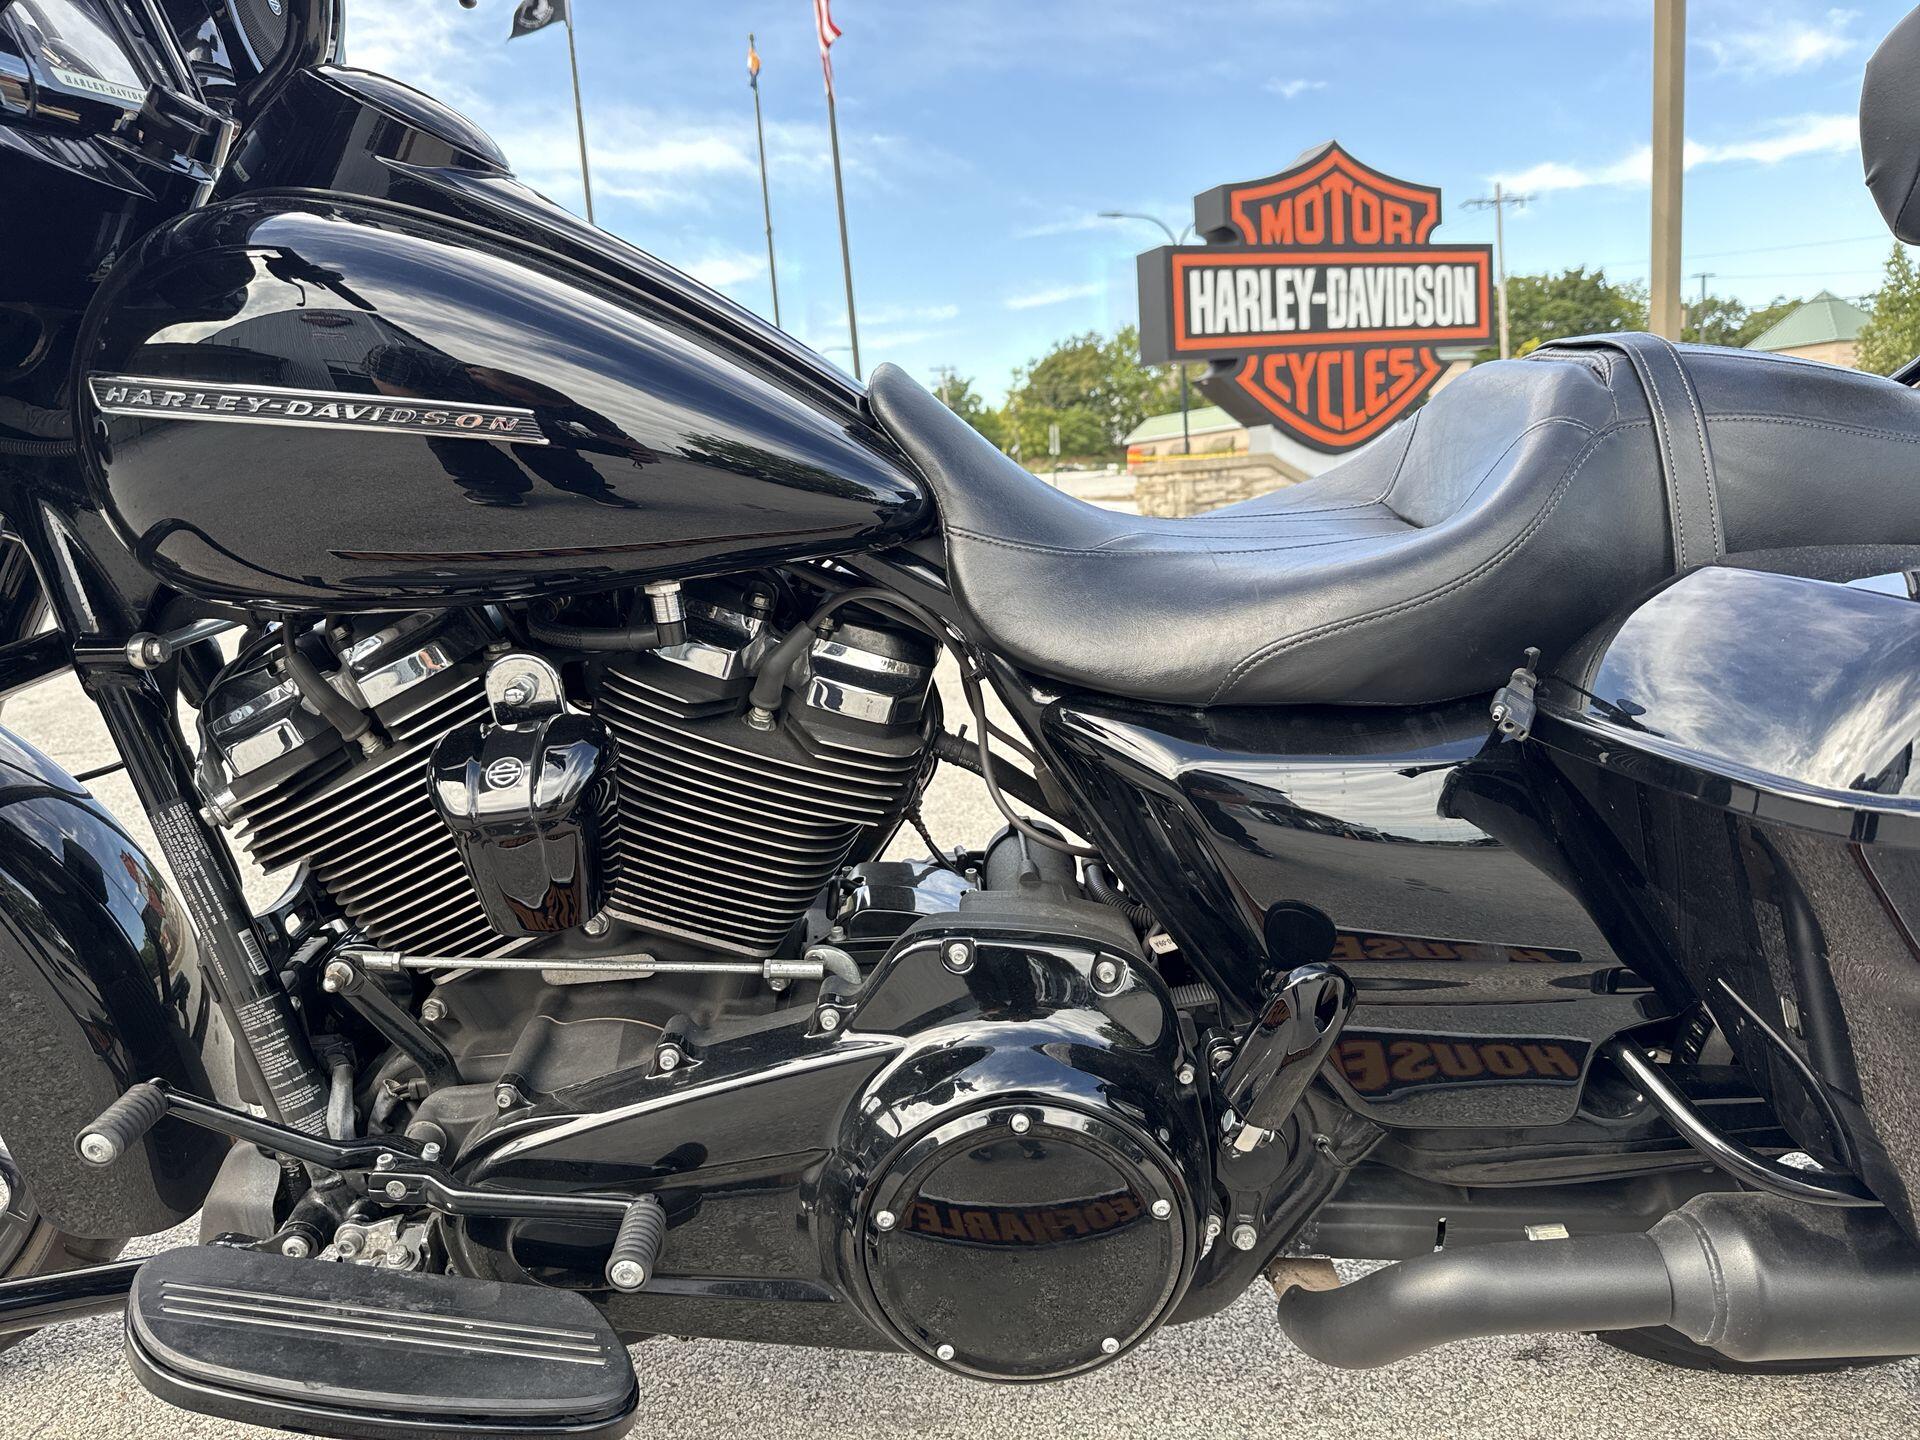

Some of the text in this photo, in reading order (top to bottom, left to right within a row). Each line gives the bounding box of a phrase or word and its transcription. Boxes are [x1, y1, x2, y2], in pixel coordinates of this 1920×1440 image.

[1261, 171, 1413, 245] MOTOR
[1189, 264, 1476, 335] HARLEY-DAVIDSON
[106, 387, 519, 433] HARLEY-DAVIDSON
[1263, 348, 1416, 431] CYCLES
